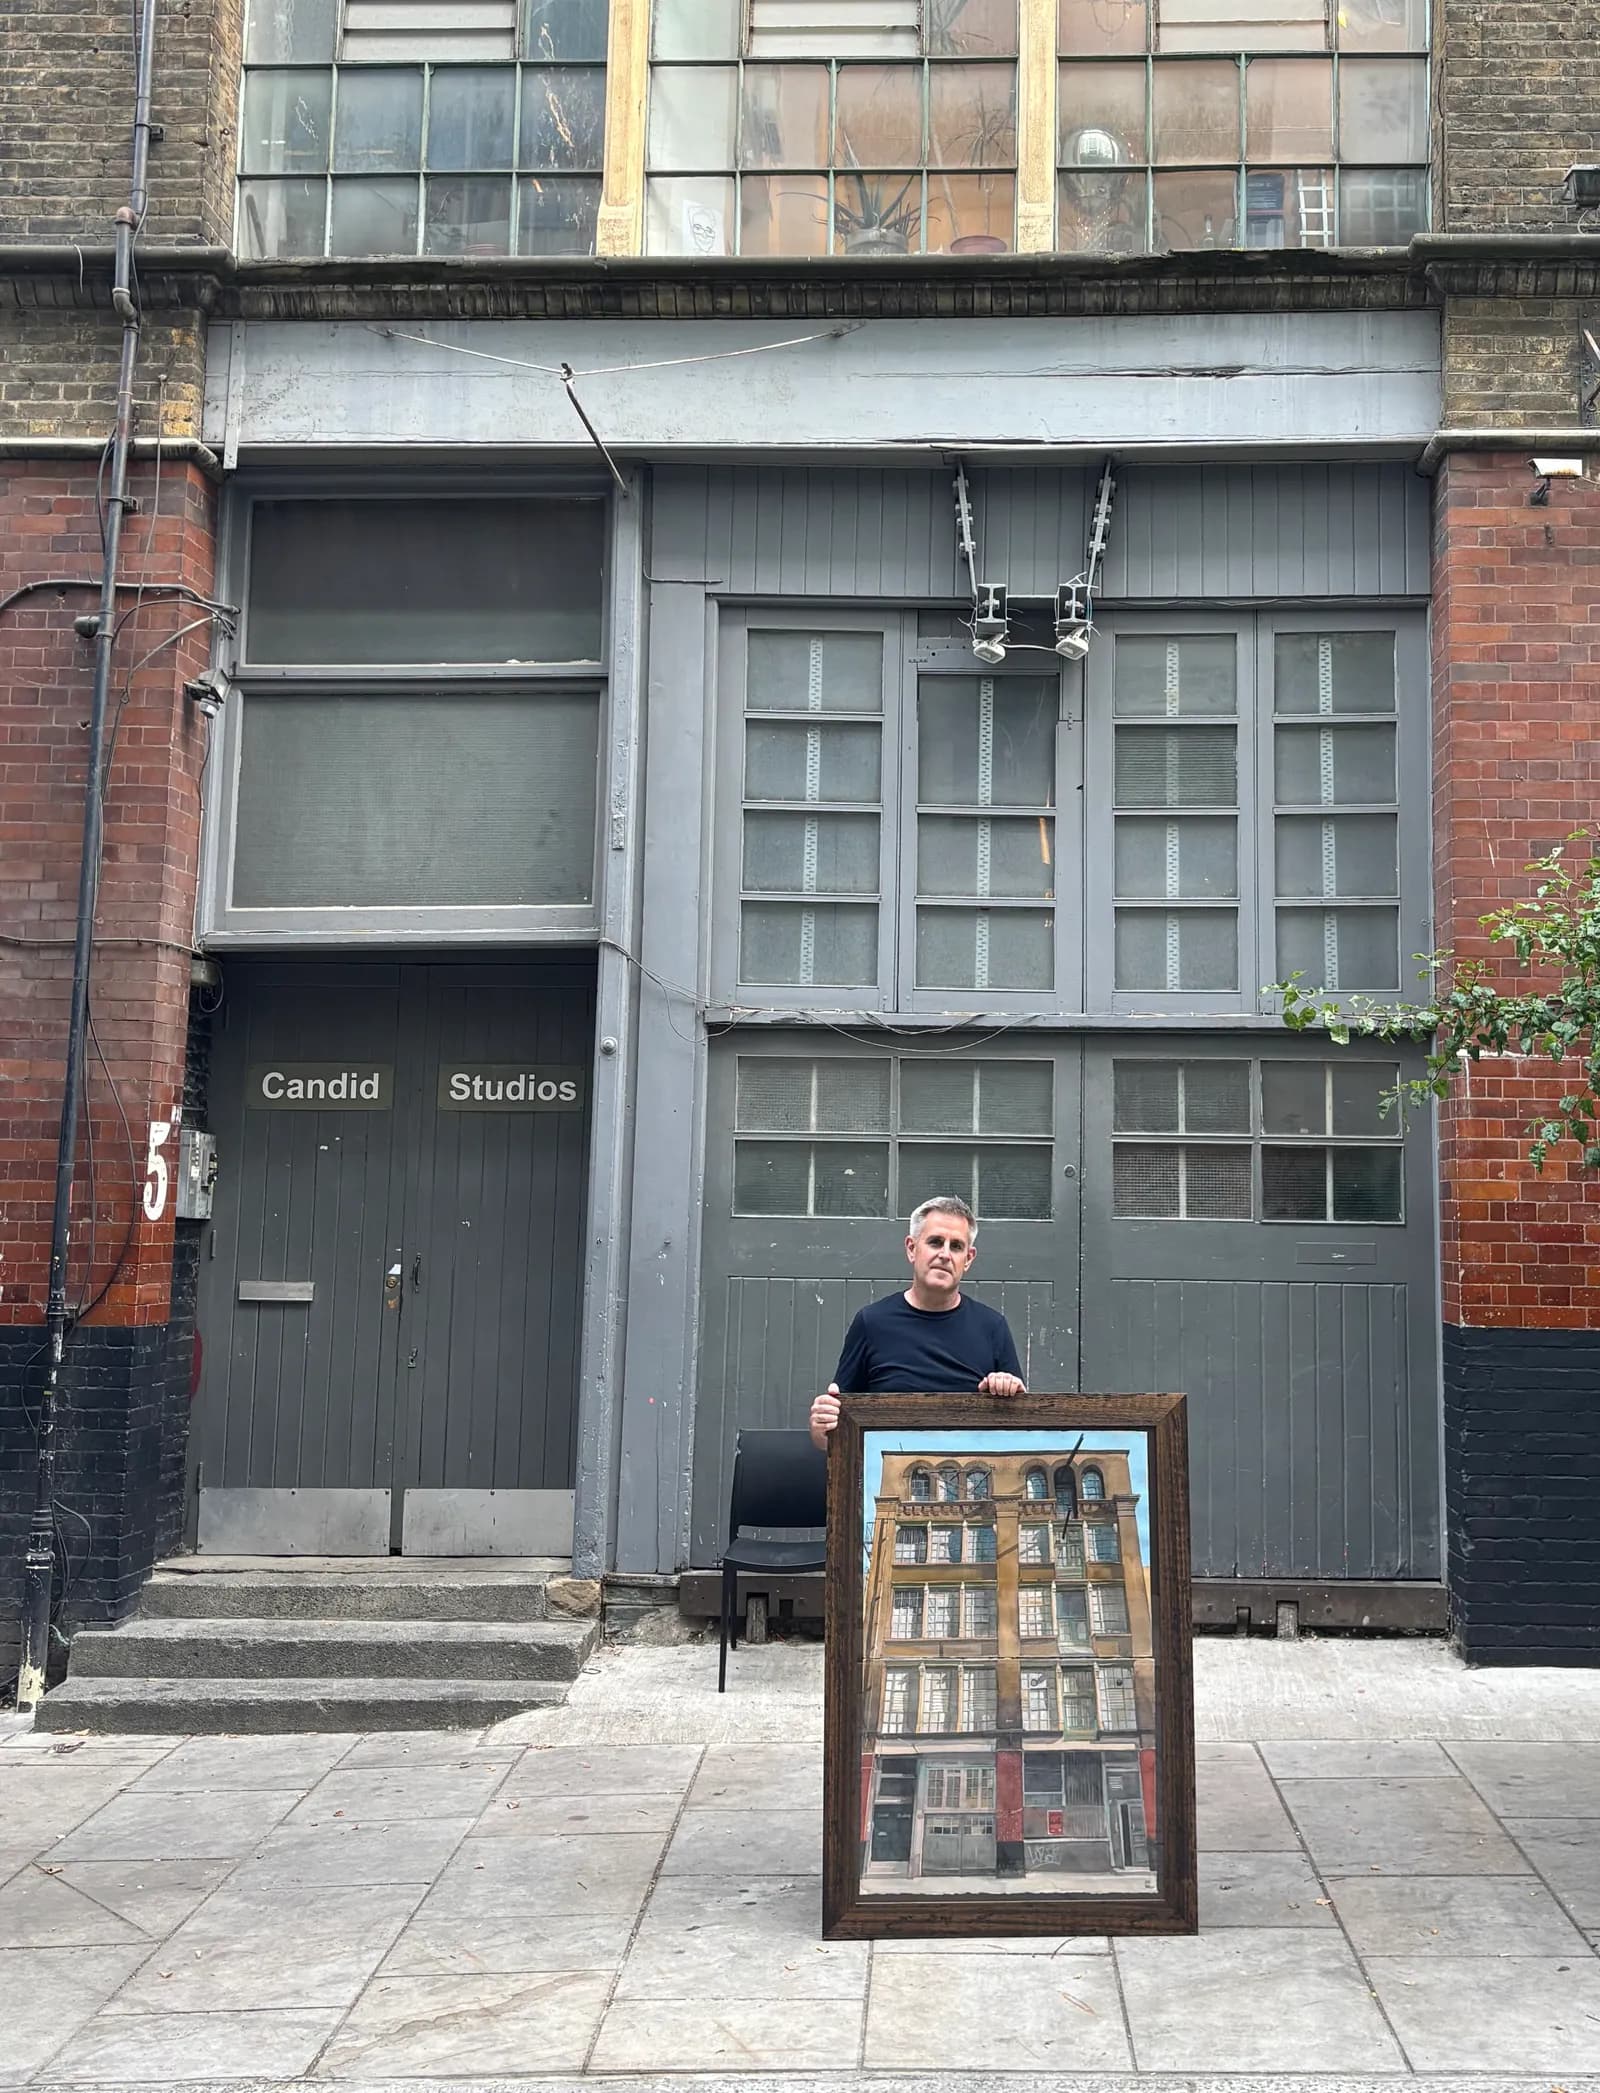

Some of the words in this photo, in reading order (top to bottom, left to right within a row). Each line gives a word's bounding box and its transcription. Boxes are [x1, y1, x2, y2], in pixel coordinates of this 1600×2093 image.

[262, 1072, 380, 1099] Candid
[449, 1073, 577, 1101] Studios
[143, 1121, 171, 1221] 5
